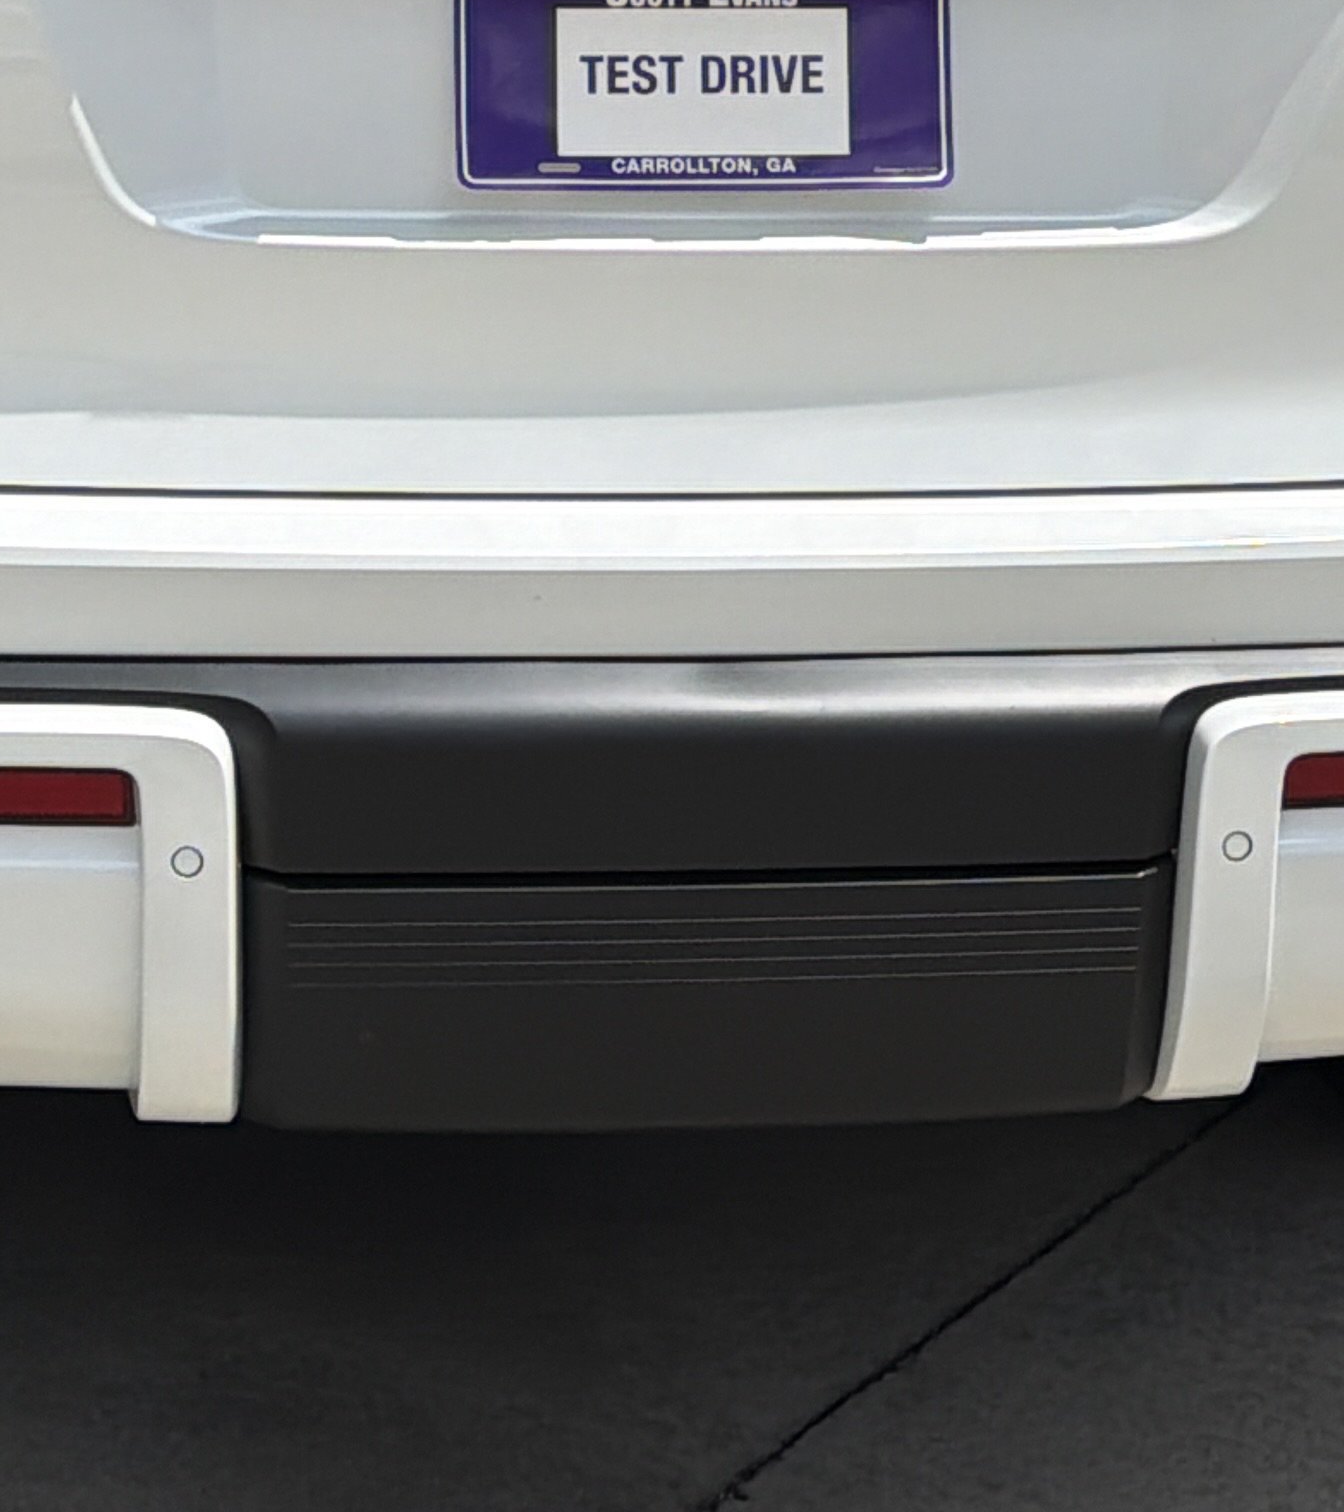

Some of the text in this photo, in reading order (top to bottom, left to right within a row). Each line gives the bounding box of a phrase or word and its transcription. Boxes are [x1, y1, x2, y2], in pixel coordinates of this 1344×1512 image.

[579, 55, 824, 94] TEST DRIVE
[611, 157, 796, 175] CARROLLTON, GA
